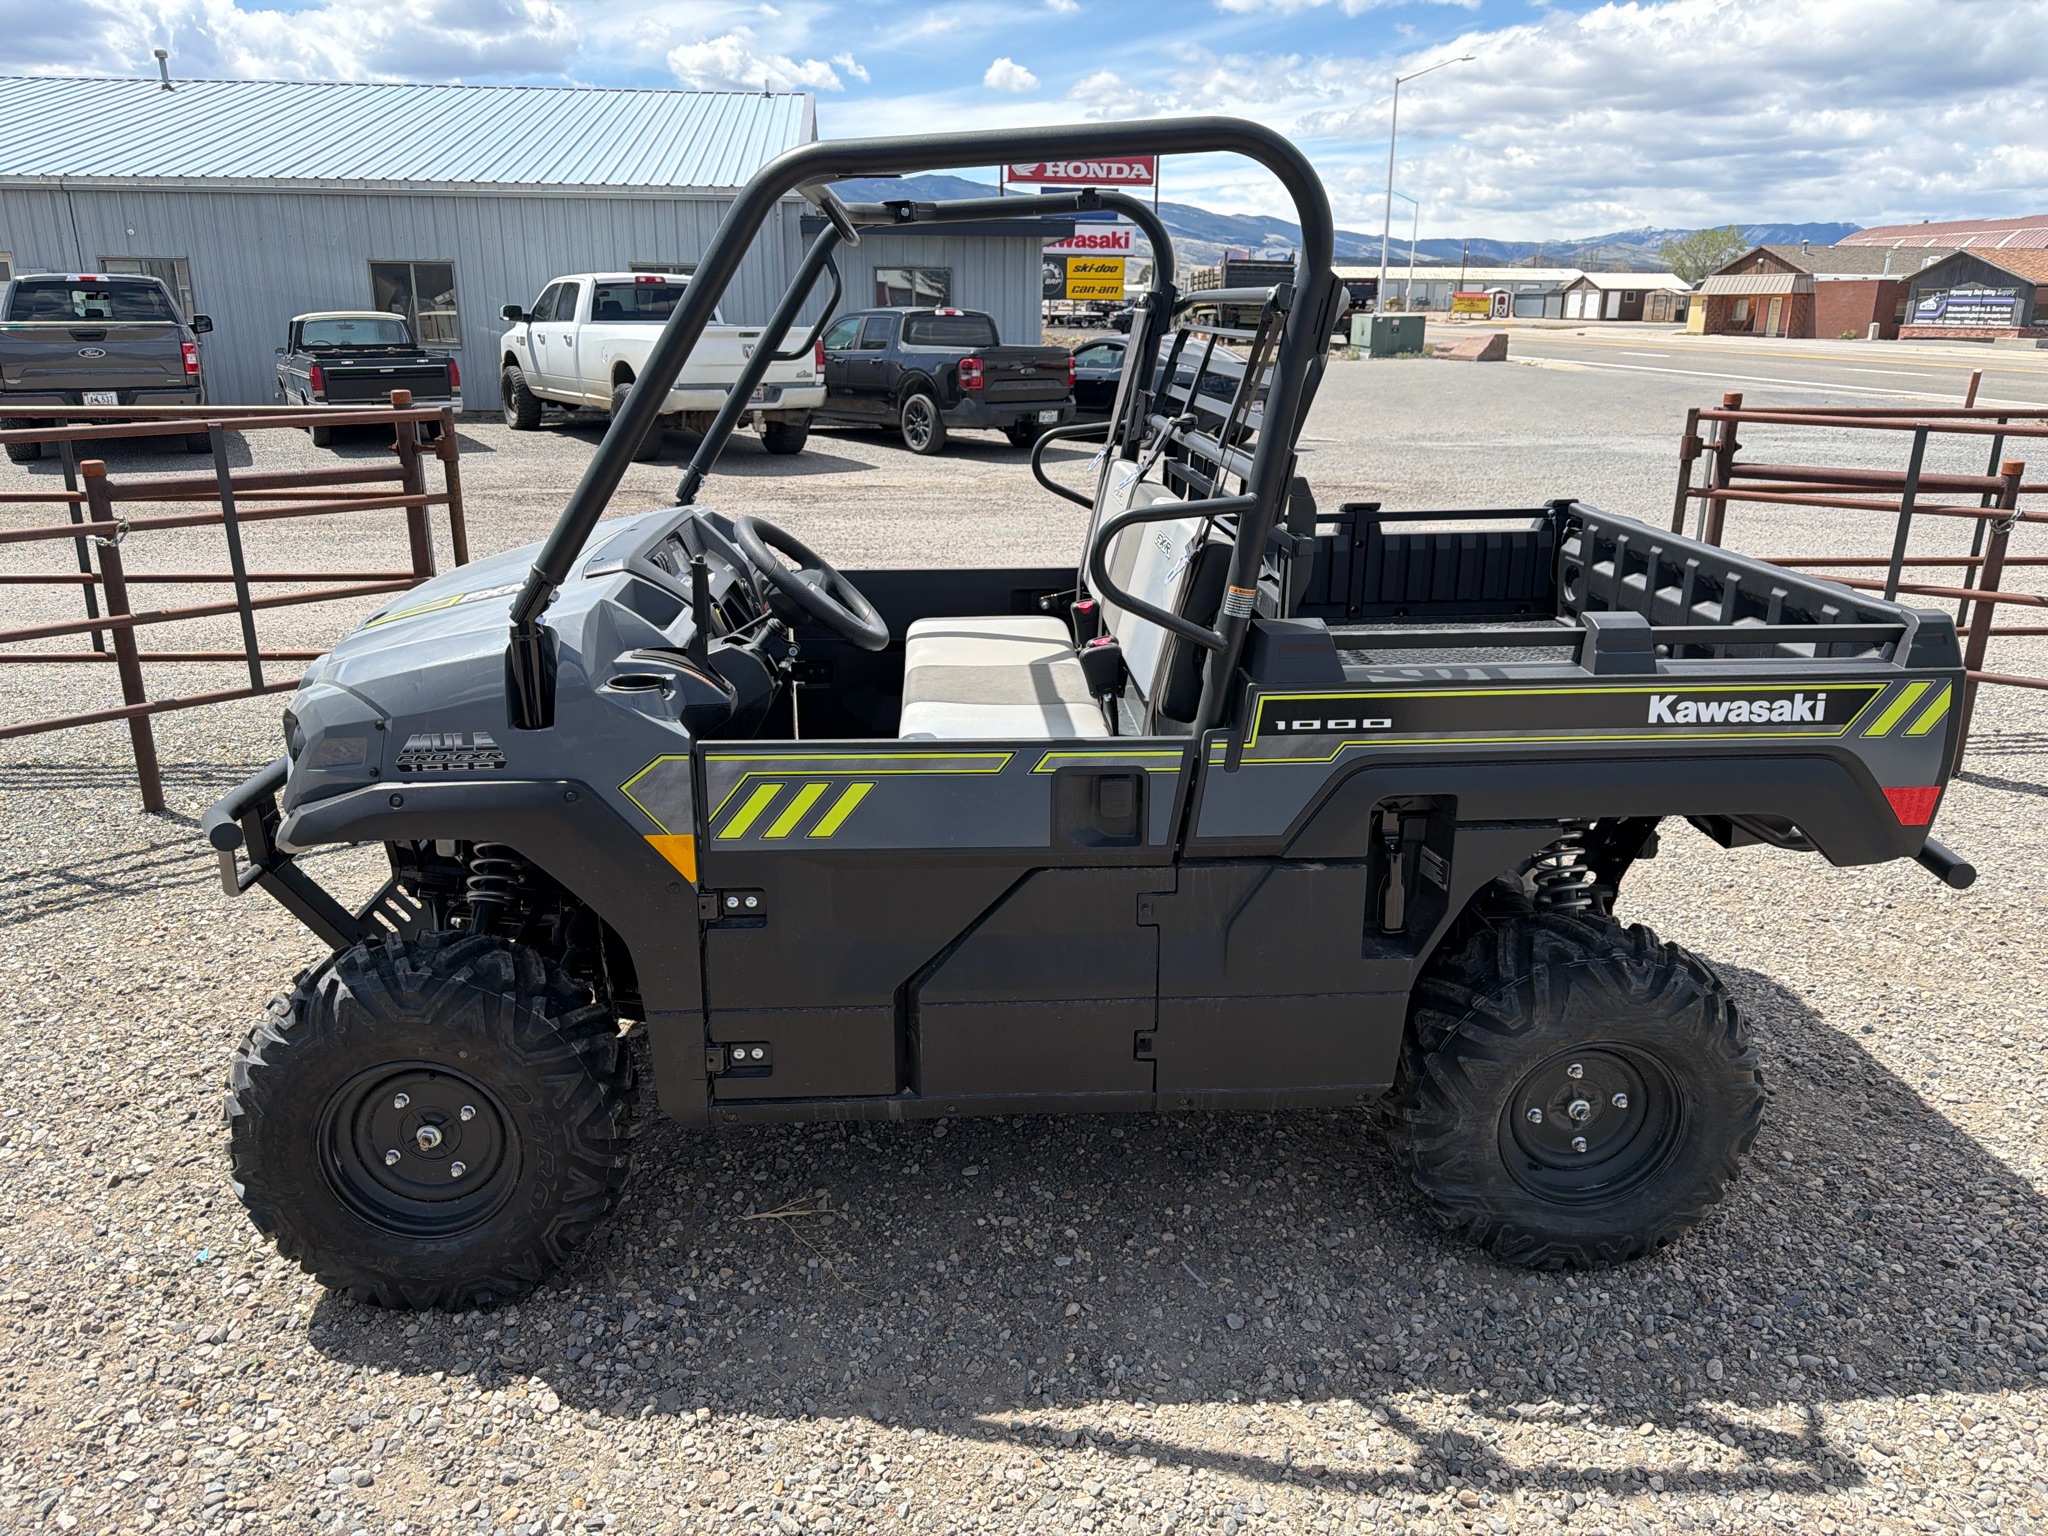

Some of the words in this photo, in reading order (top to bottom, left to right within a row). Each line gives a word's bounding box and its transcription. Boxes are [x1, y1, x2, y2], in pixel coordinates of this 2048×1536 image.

[1044, 161, 1152, 179] HONDA
[1044, 231, 1130, 249] wasaki
[1073, 263, 1119, 273] ski-doo
[1071, 285, 1119, 294] can-am
[1997, 288, 2017, 296] Supply
[1154, 531, 1172, 557] FXR
[1647, 692, 1827, 726] Kawasaki
[1275, 715, 1394, 732] 1000
[400, 732, 502, 754] MULE
[409, 762, 496, 772] 1000
